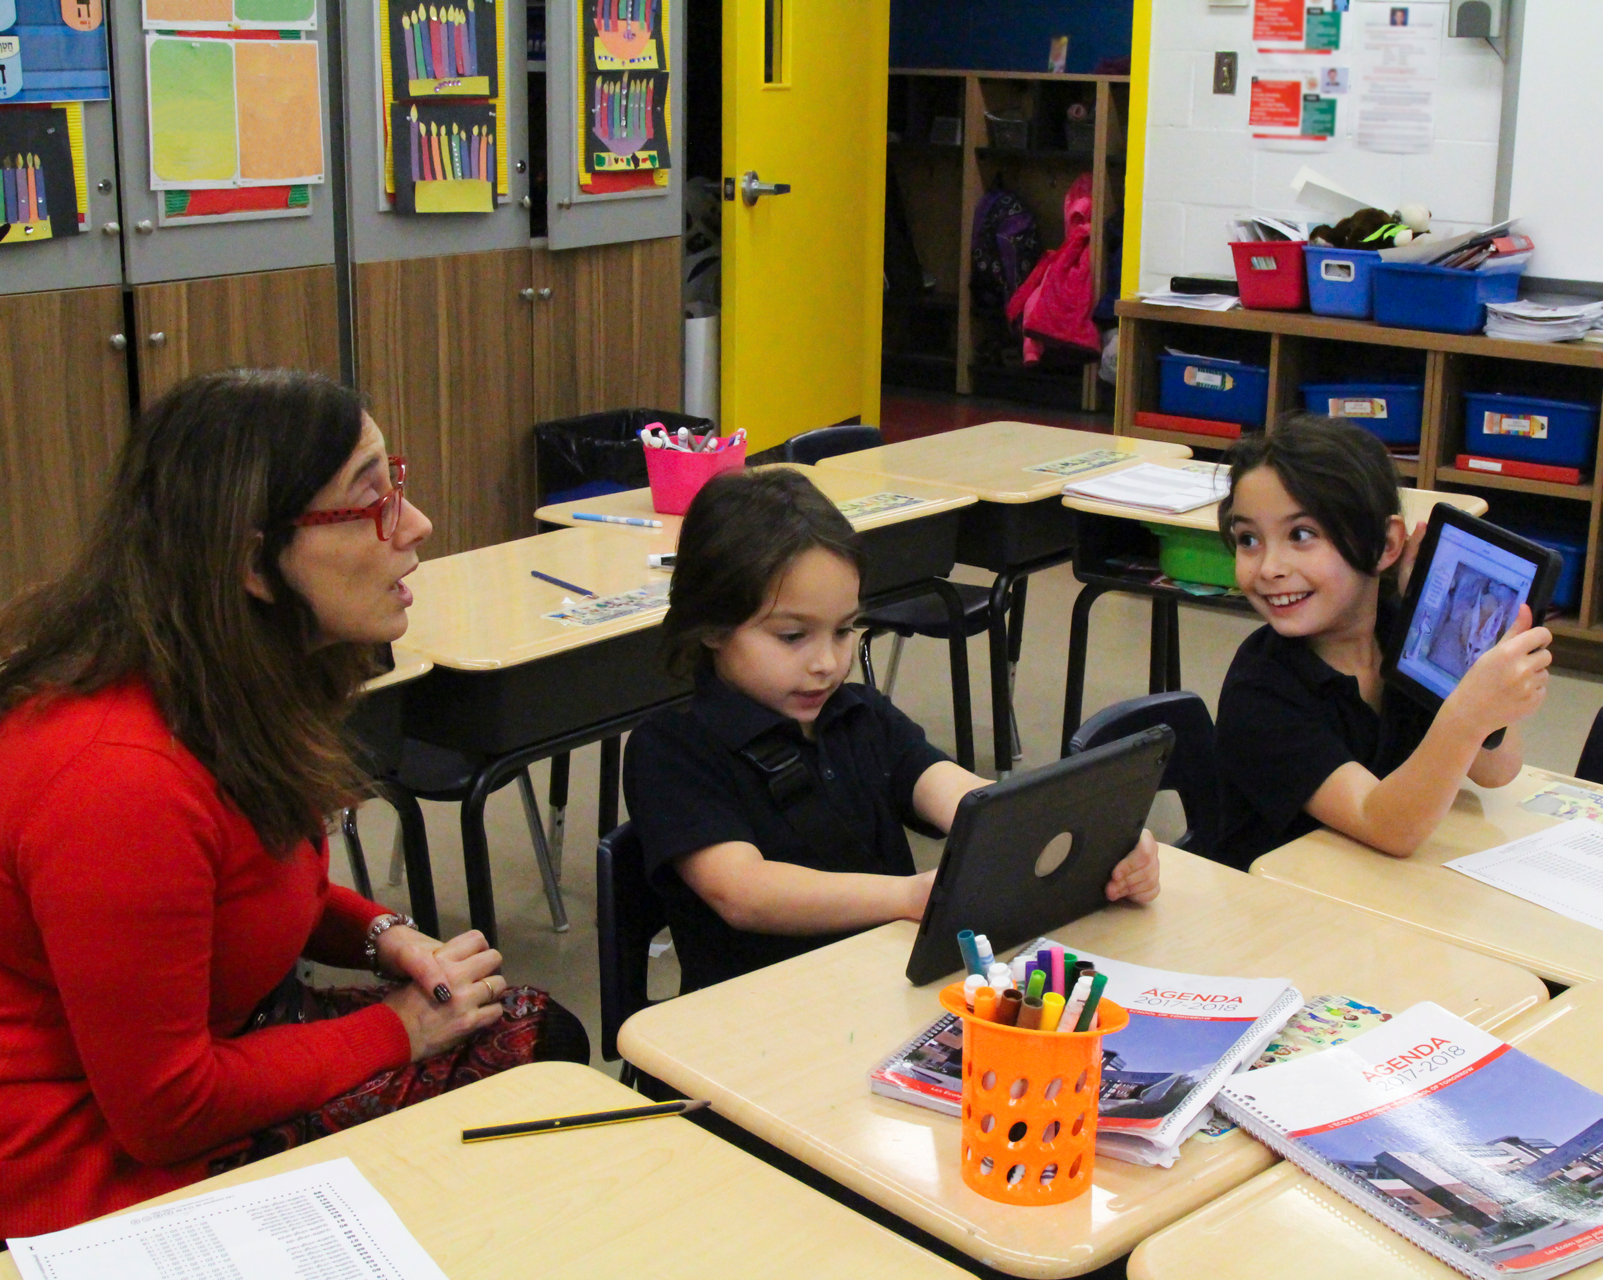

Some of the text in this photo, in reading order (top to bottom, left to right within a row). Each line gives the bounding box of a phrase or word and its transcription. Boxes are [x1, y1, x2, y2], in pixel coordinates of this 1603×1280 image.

[1134, 996, 1238, 1012] 2017-2018
[1141, 989, 1243, 1004] AGENDA
[1362, 1037, 1451, 1082] AGENDA
[1376, 1045, 1465, 1092] 2017-2018
